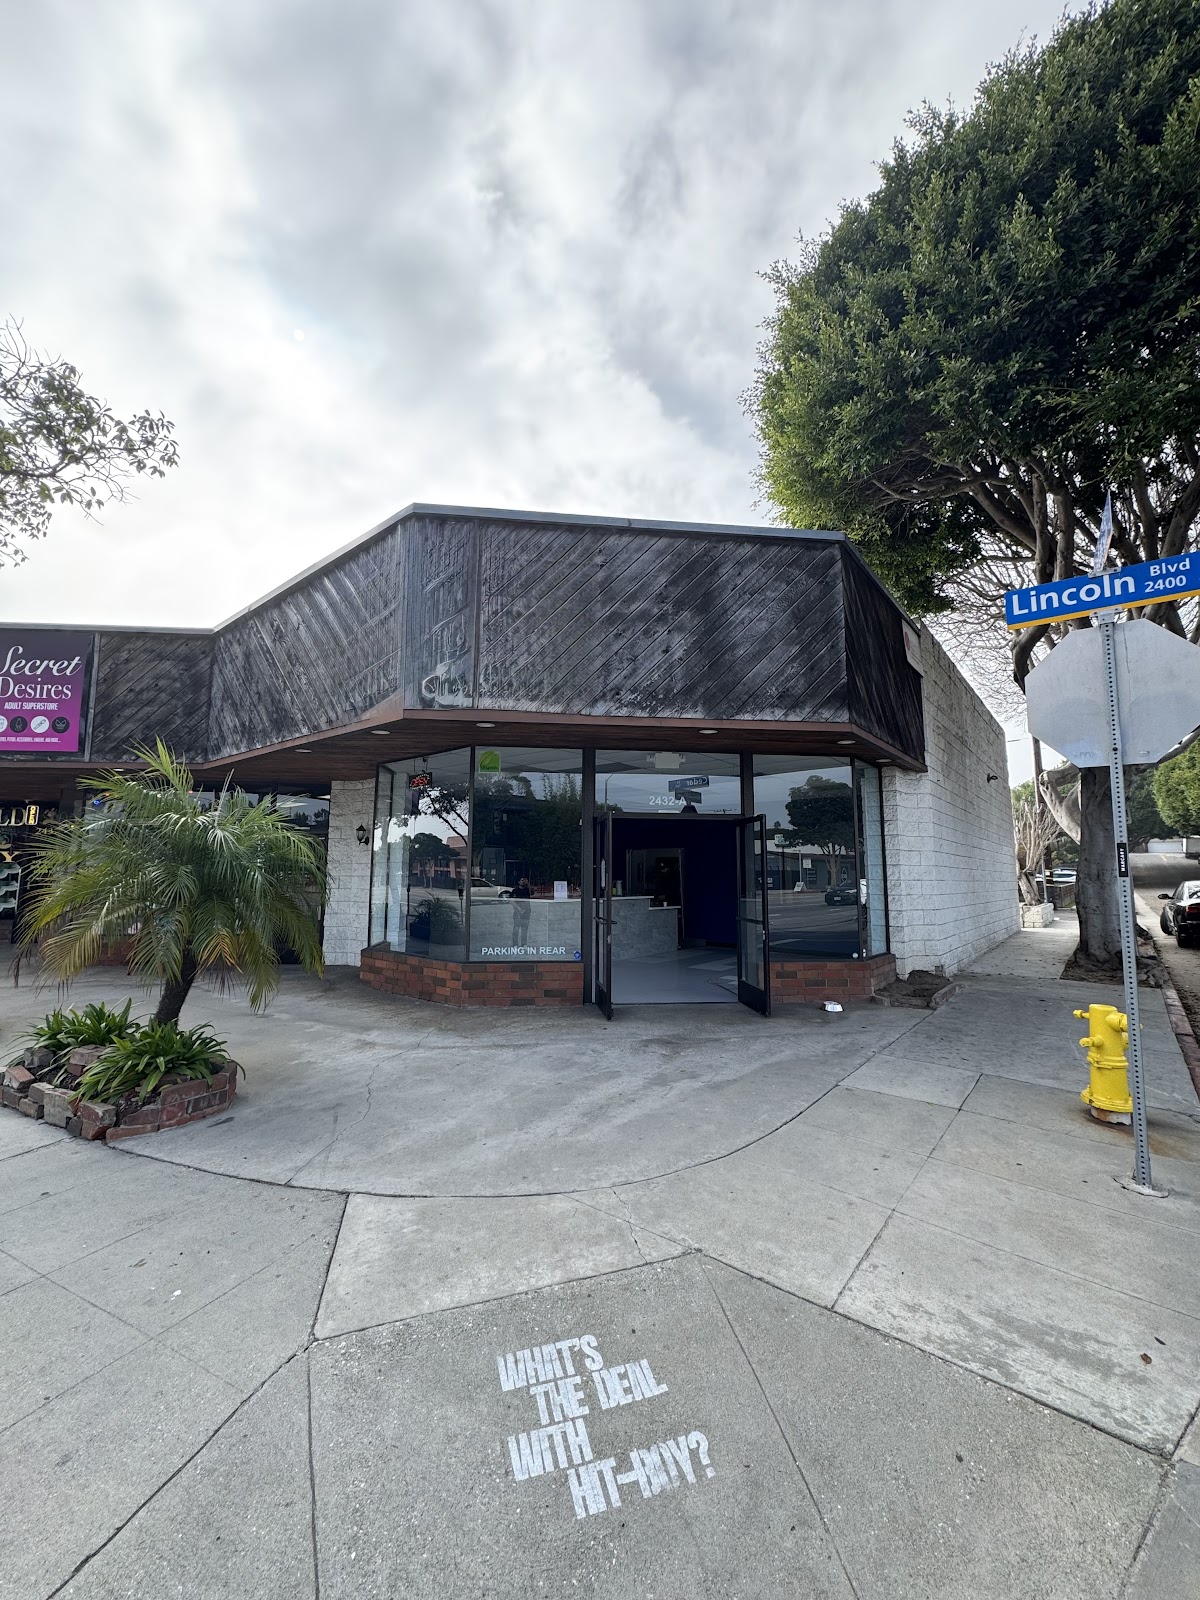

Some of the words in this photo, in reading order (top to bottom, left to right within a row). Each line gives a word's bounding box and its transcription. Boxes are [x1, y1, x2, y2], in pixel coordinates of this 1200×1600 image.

[1012, 575, 1136, 616] Lincoln
[1149, 558, 1191, 577] Blvd
[1144, 575, 1187, 592] 2400
[0, 645, 83, 676] Secret
[0, 677, 72, 699] Desires
[4, 702, 21, 710] ADULT
[22, 702, 59, 711] SUPERSTORE
[649, 796, 687, 806] 2432-A
[481, 947, 525, 955] PARKING
[496, 1335, 604, 1392] WHAT'S
[530, 1376, 590, 1426] THE
[592, 1358, 668, 1410] DEAL
[507, 1418, 593, 1482] WITH
